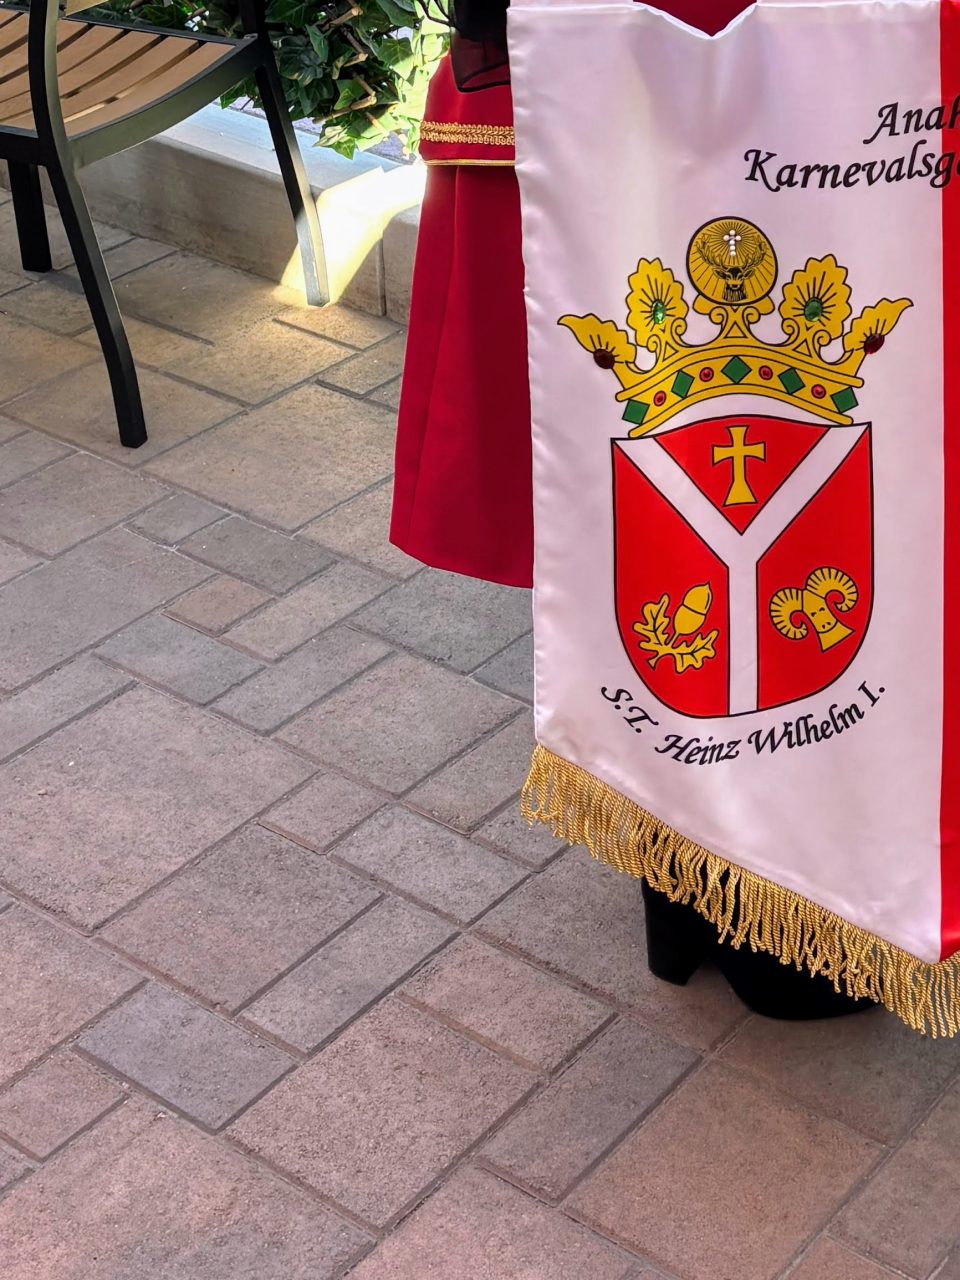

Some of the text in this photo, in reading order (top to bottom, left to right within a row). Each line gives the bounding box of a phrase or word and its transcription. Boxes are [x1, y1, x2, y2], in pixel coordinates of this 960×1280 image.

[601, 680, 886, 766] S.T. Heinz Wilhelm I.
